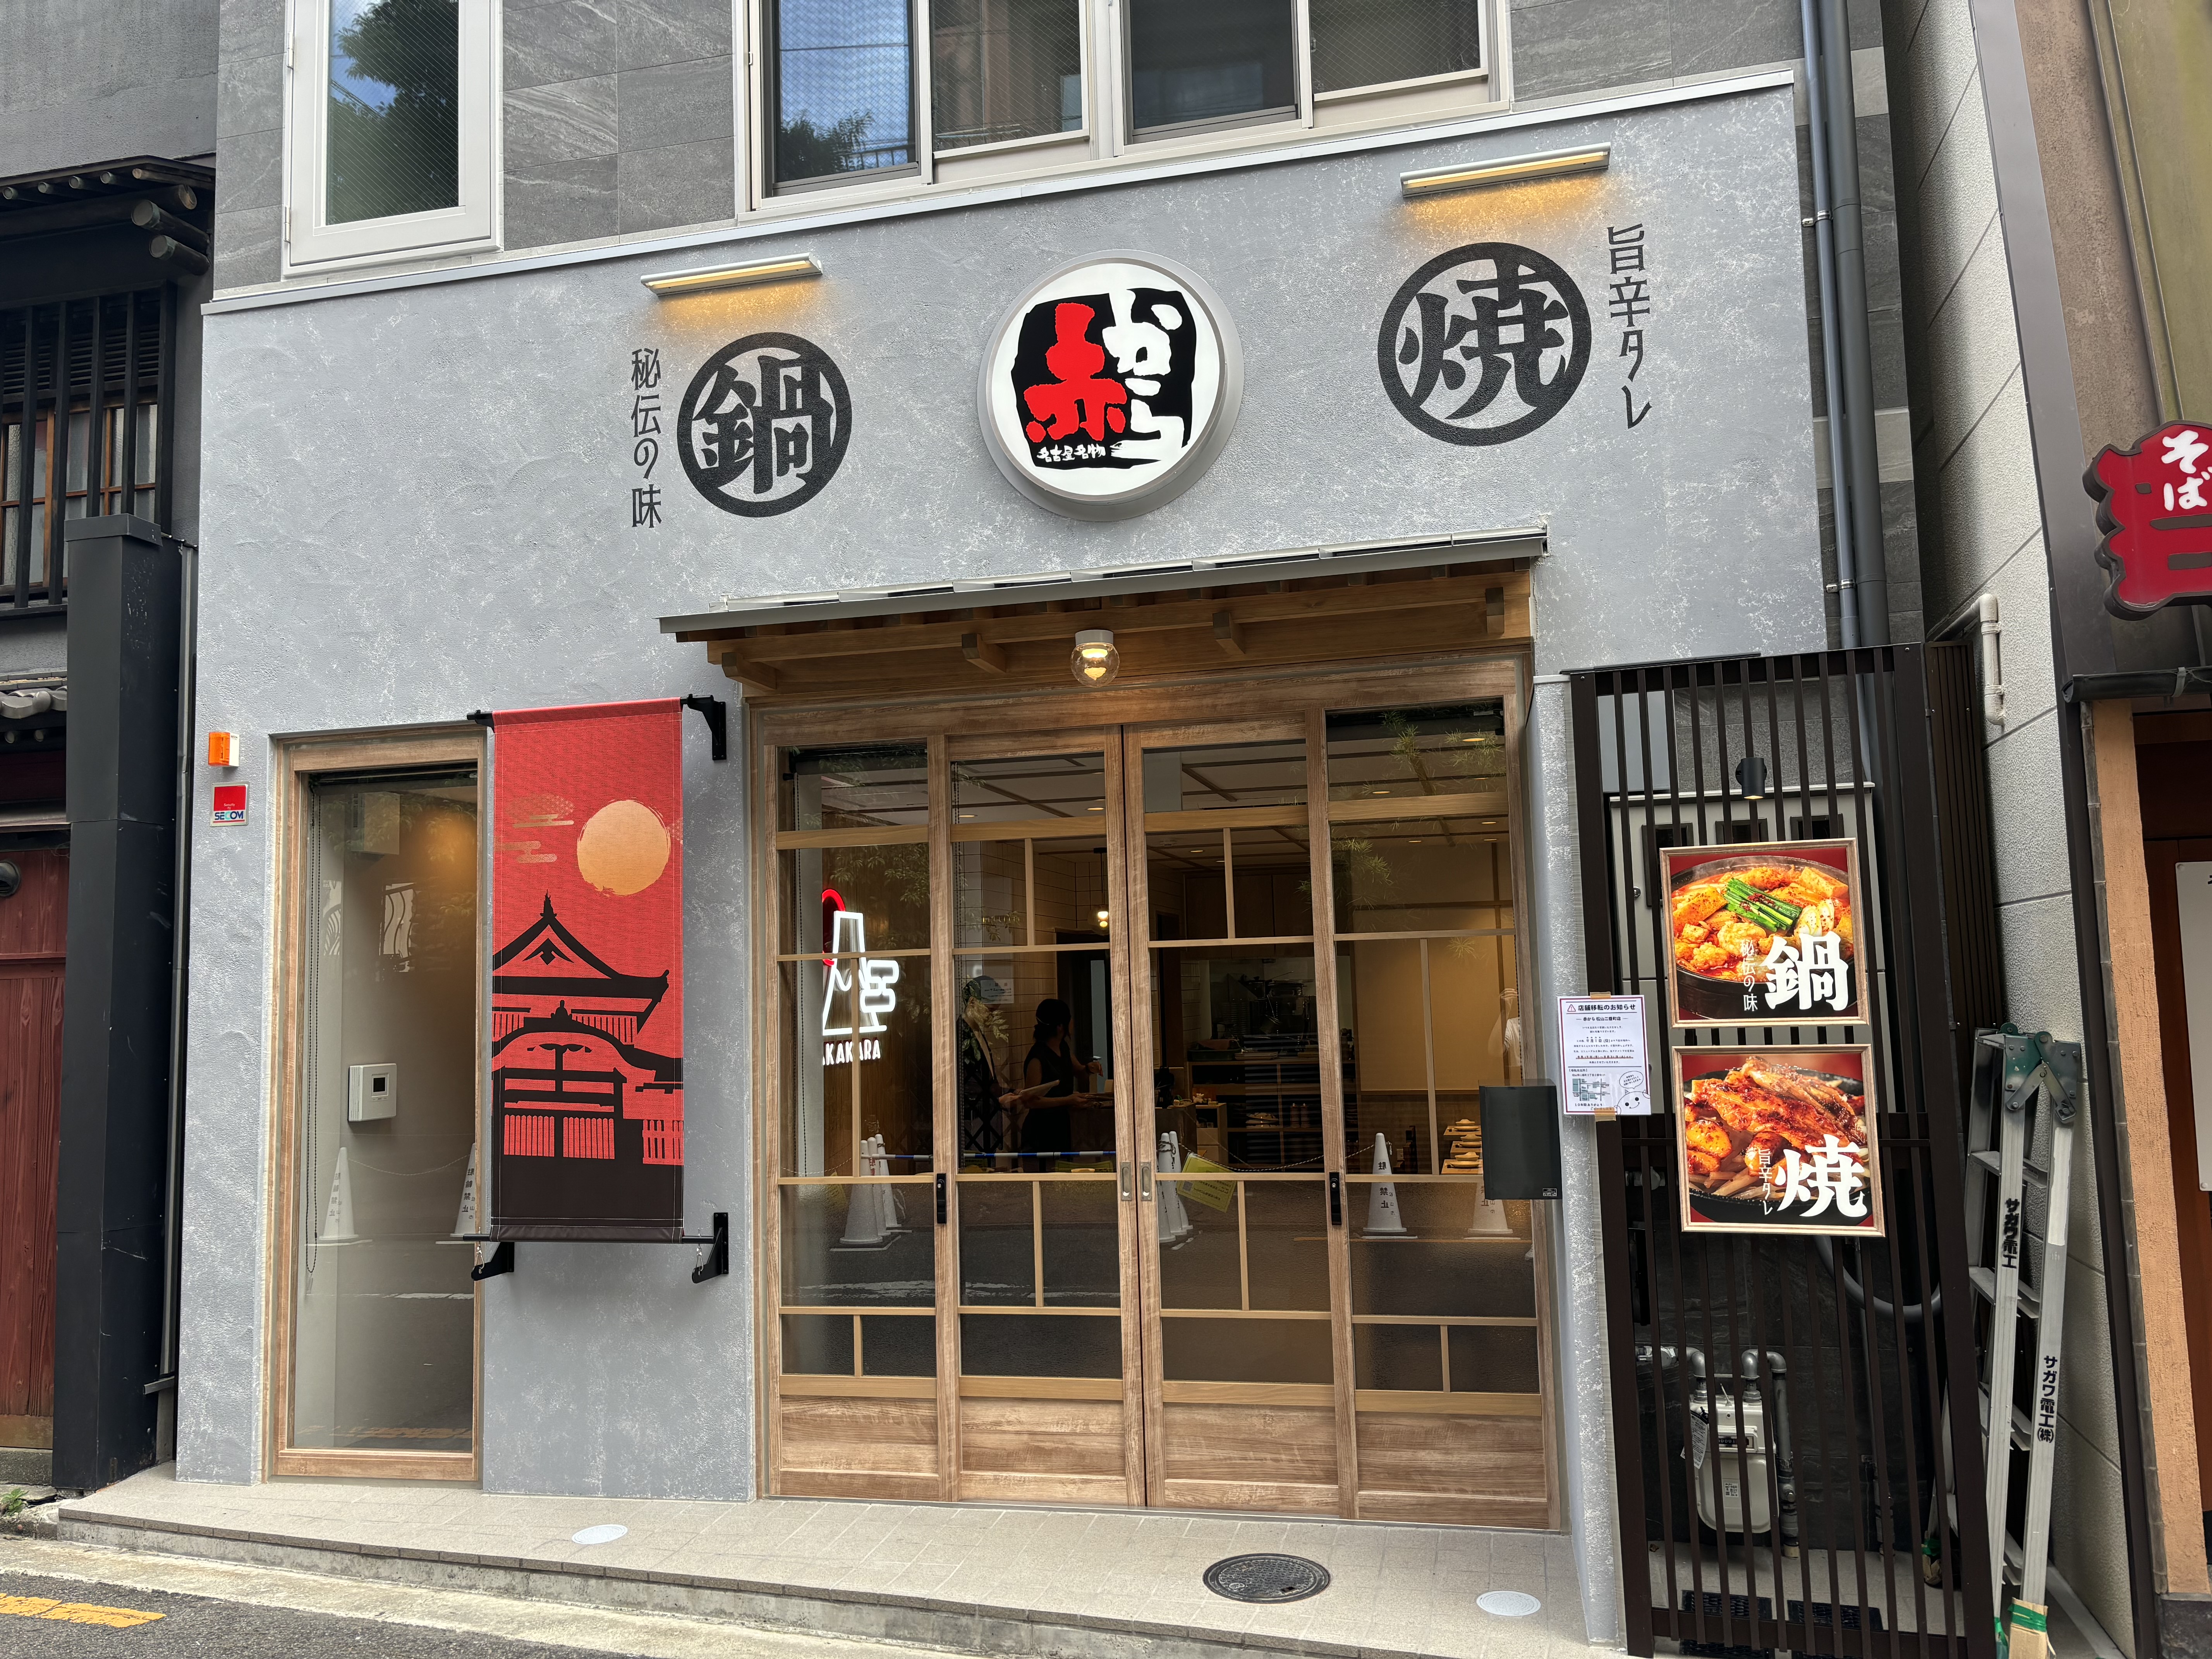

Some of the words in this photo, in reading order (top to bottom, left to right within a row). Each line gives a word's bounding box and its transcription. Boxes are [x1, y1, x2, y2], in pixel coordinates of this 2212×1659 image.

[1396, 256, 1573, 423] 焼
[1607, 223, 1652, 429] 旨辛タレ
[631, 348, 662, 528] 秘伝の味
[692, 352, 836, 496] 鍋
[1037, 443, 1106, 462] 名古屋名物
[2161, 430, 2212, 511] そば
[215, 811, 244, 820] SECOM
[1740, 939, 1758, 1012] 秘伝の味
[1760, 931, 1848, 1011] 鍋
[1758, 1148, 1772, 1215] 旨辛タレ
[1775, 1134, 1867, 1217] 焼
